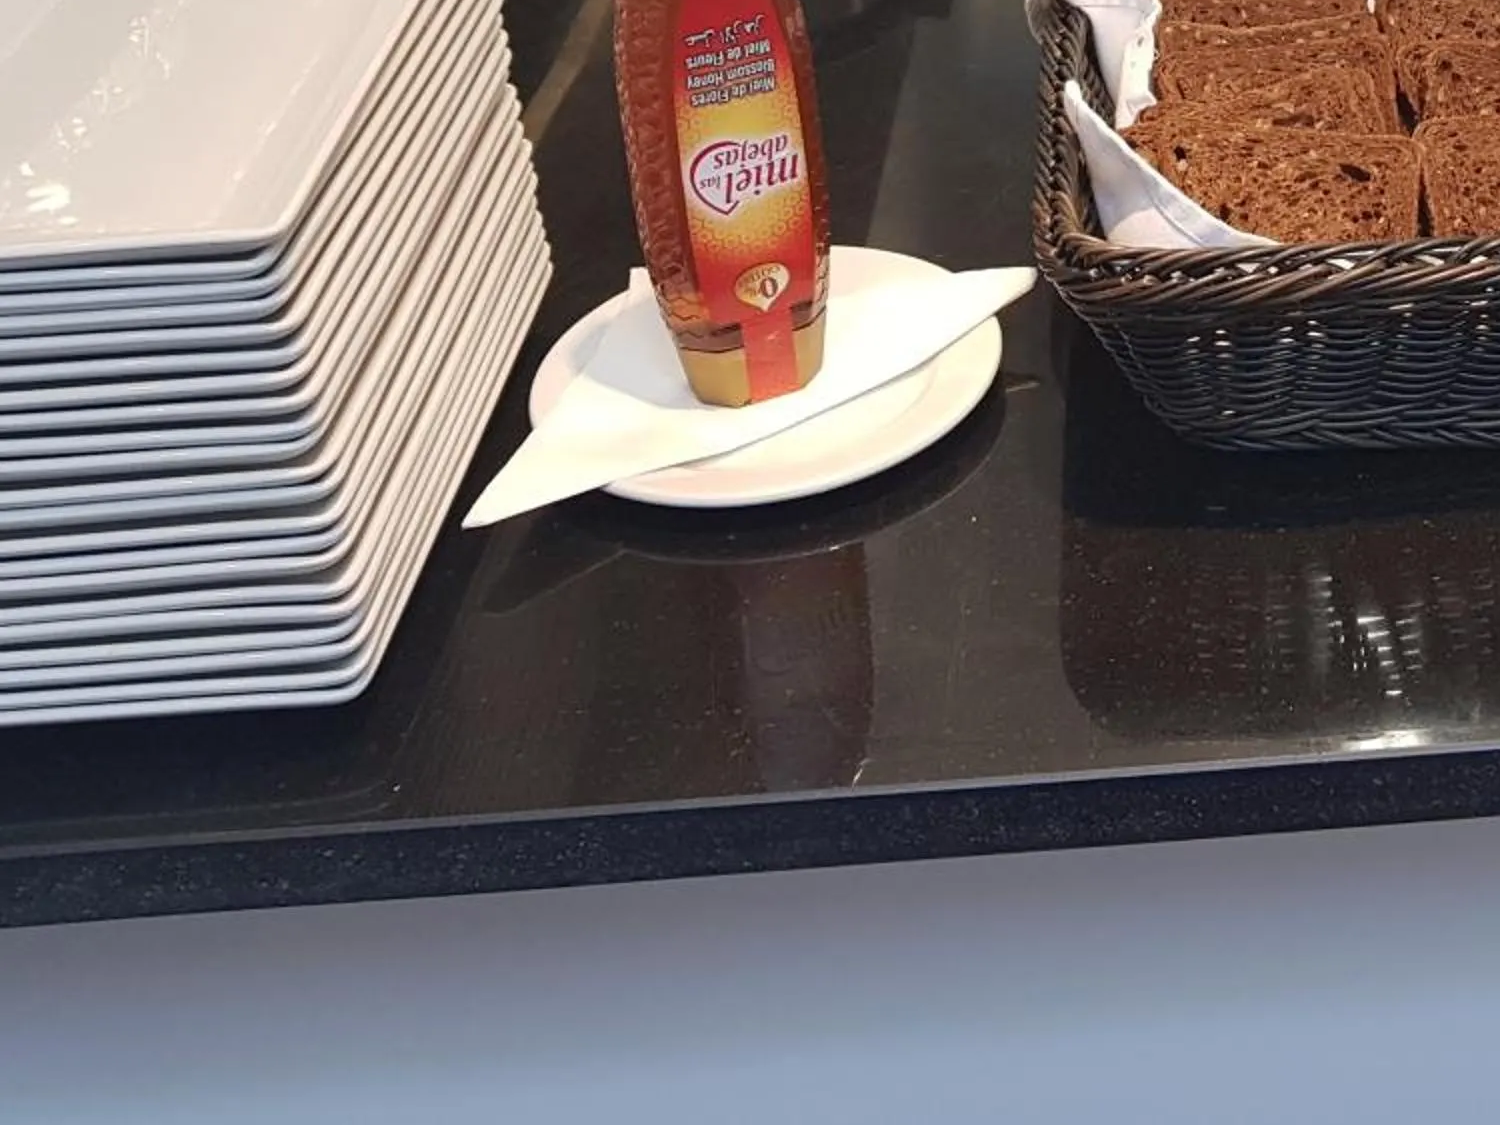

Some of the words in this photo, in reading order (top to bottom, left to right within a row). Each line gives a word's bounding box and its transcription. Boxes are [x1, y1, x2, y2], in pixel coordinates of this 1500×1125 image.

[727, 46, 742, 60] de
[744, 39, 771, 57] Miel
[684, 51, 725, 69] Fleurs
[687, 71, 725, 90] Honey
[731, 83, 747, 96] de
[749, 75, 775, 93] Miel
[691, 89, 729, 106] Flores
[713, 134, 788, 169] abejas
[700, 176, 721, 190] las
[726, 153, 799, 204] miel
